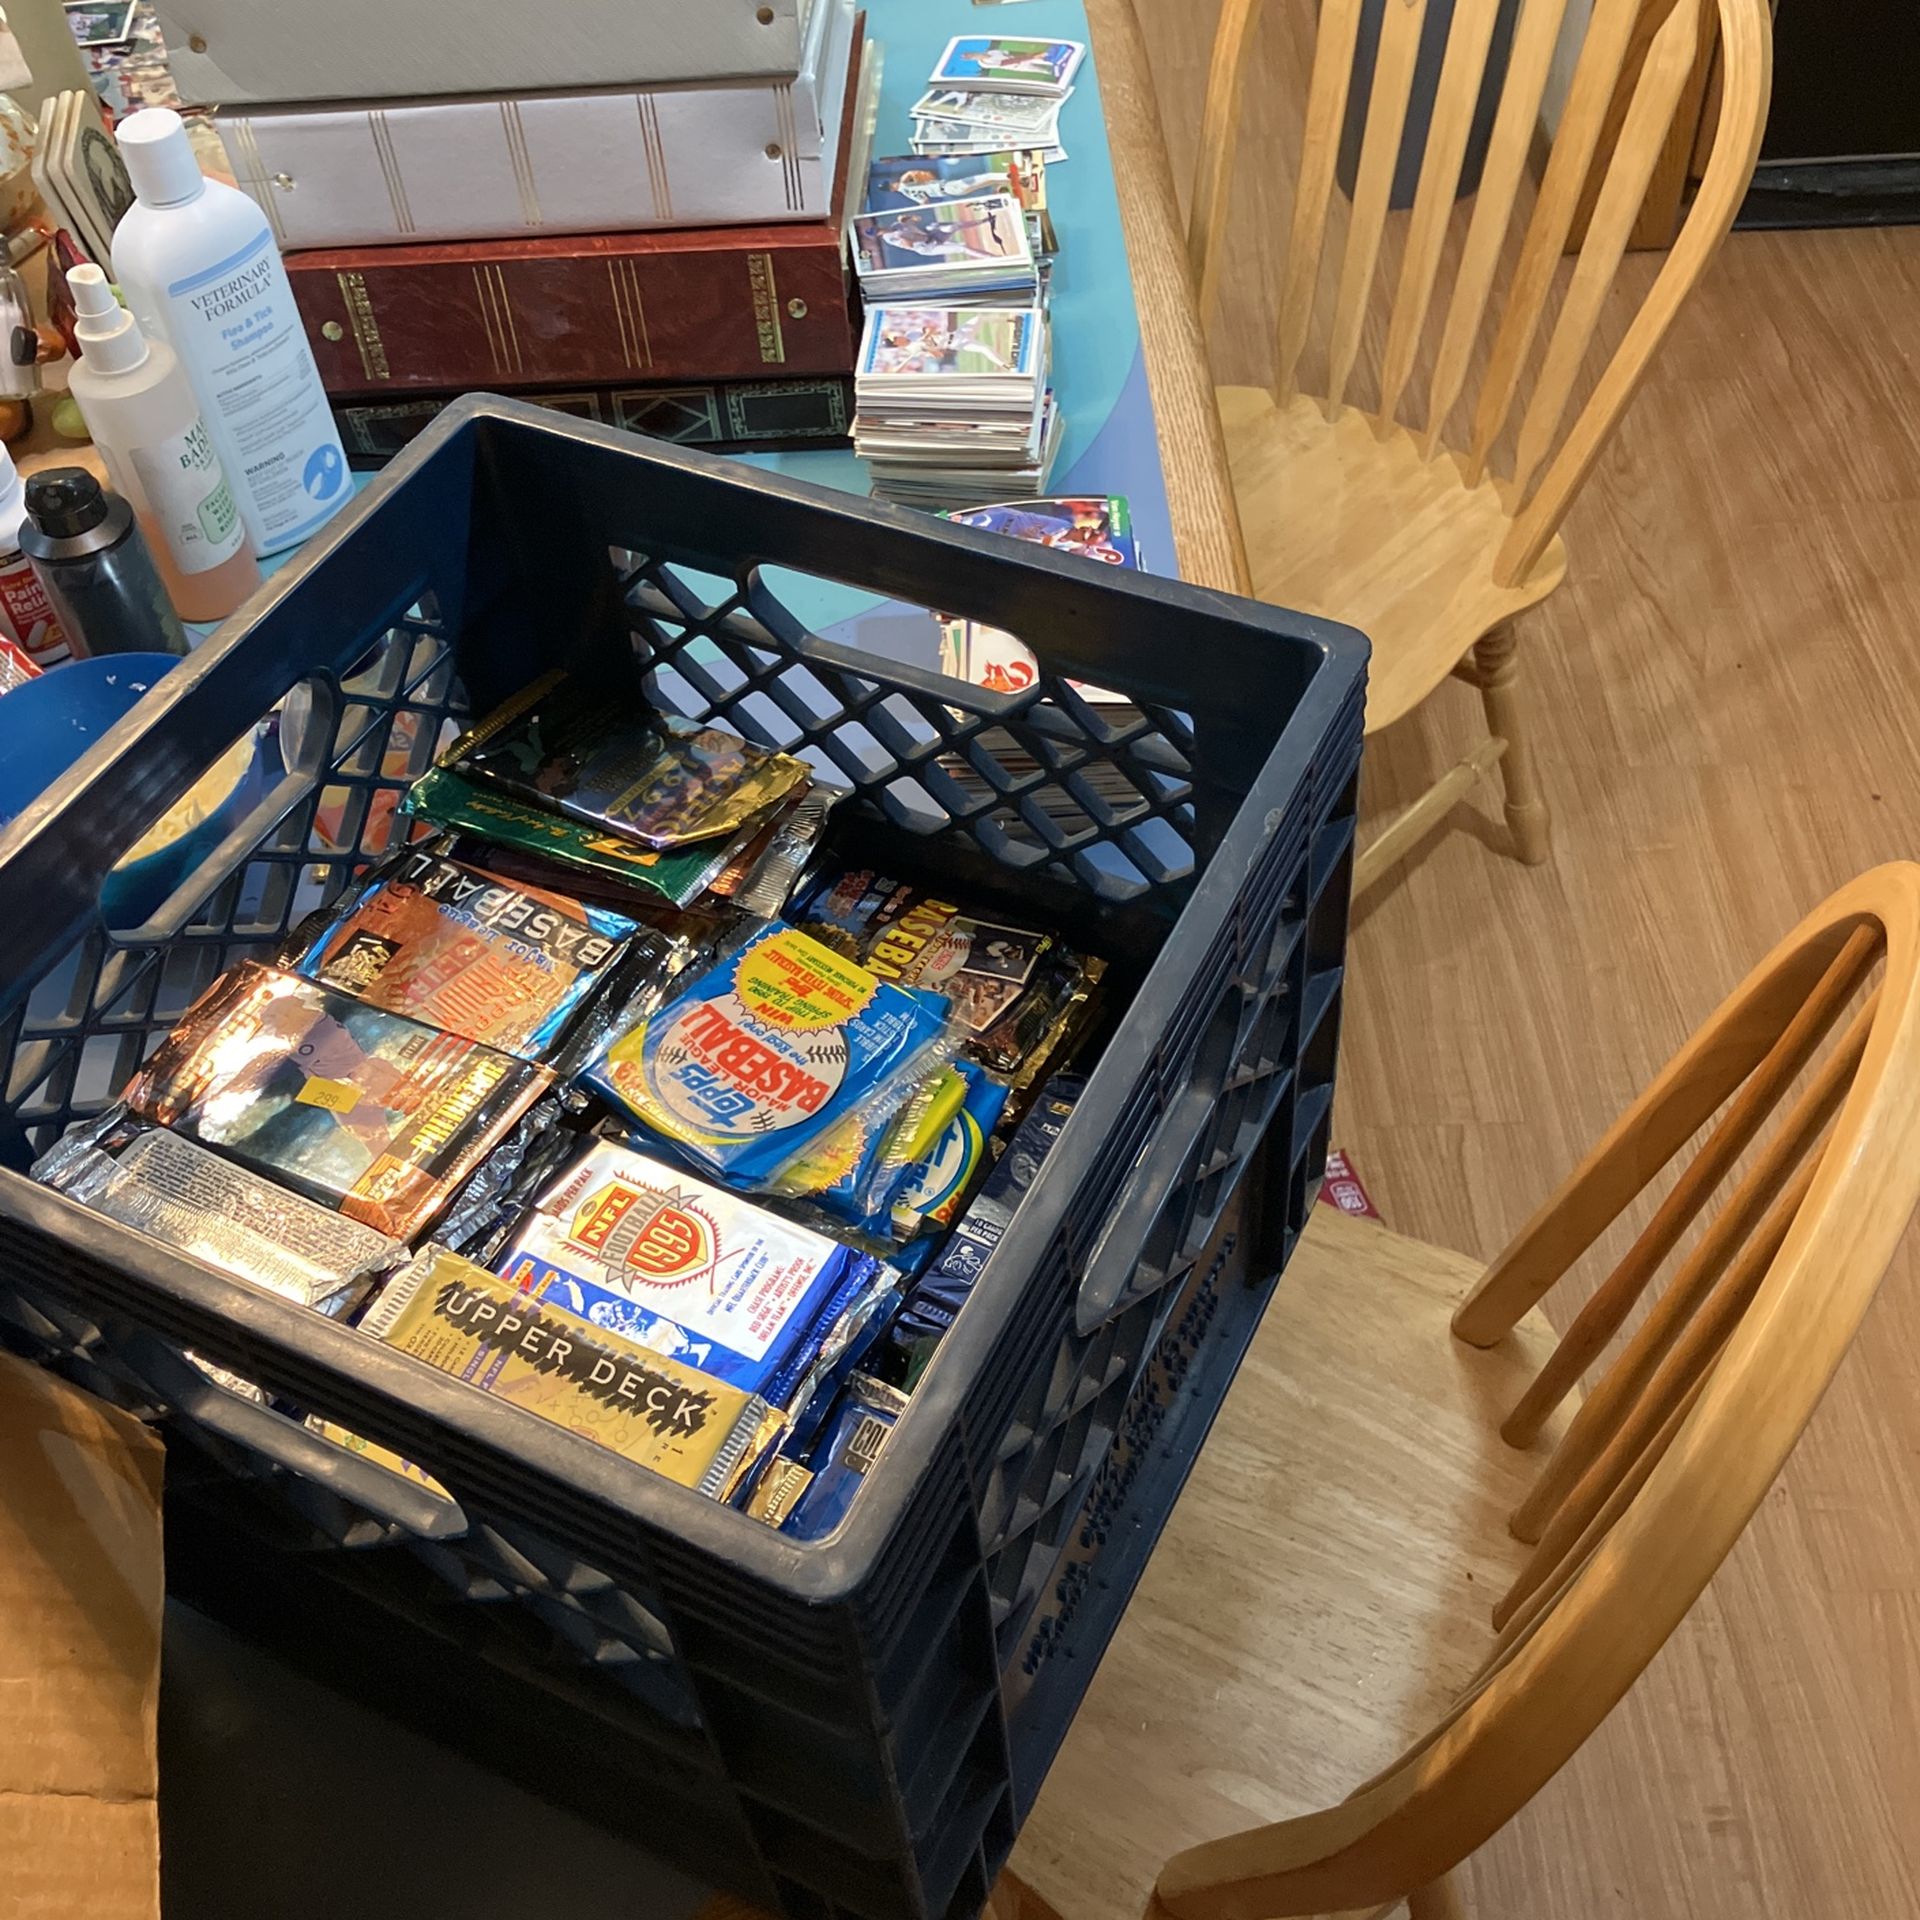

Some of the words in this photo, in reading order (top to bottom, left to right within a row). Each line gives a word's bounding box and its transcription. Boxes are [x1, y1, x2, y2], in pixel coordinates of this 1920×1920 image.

[190, 256, 270, 309] VETERINARY
[229, 321, 275, 351] Shampoo
[245, 451, 286, 476] WARNING
[5, 582, 42, 603] Pain
[10, 594, 48, 616] Reli
[407, 853, 613, 965] BASEBALL
[436, 902, 497, 945] League
[504, 938, 555, 972] Major
[806, 953, 833, 973] NECESSARY
[748, 975, 792, 1000] TRAINING
[832, 970, 858, 989] PURCHASE
[755, 1002, 793, 1025] WIN
[772, 996, 785, 1008] TO
[784, 1004, 809, 1019] TRIP
[794, 997, 831, 1018] SPRING
[737, 1015, 766, 1039] one!
[849, 1017, 875, 1037] CARDS
[872, 1018, 895, 1037] STICK
[761, 1031, 792, 1056] Real
[679, 1032, 730, 1081] LEAGUE
[679, 1001, 830, 1112] BASEBALL
[789, 1049, 808, 1067] the
[313, 1089, 339, 1108] 299
[410, 1057, 506, 1154] PREDICTOR
[733, 1079, 791, 1112] MAJOR
[562, 1182, 580, 1201] PER
[572, 1165, 593, 1188] PACK
[585, 1194, 630, 1243] NFL
[601, 1192, 664, 1262] FOOTBALL
[632, 1211, 692, 1268] 1995
[970, 1224, 984, 1236] PER
[982, 1229, 998, 1243] PACK
[731, 1266, 759, 1302] QUARTERBACK
[747, 1295, 764, 1314] CHASE
[758, 1263, 785, 1298] PROGRAMS:
[749, 1319, 761, 1333] RED
[787, 1256, 804, 1276] PROOF
[757, 1319, 776, 1342] DREAM
[446, 1292, 574, 1366] UPPER
[590, 1358, 700, 1427] DECK
[486, 1358, 502, 1380] NFL
